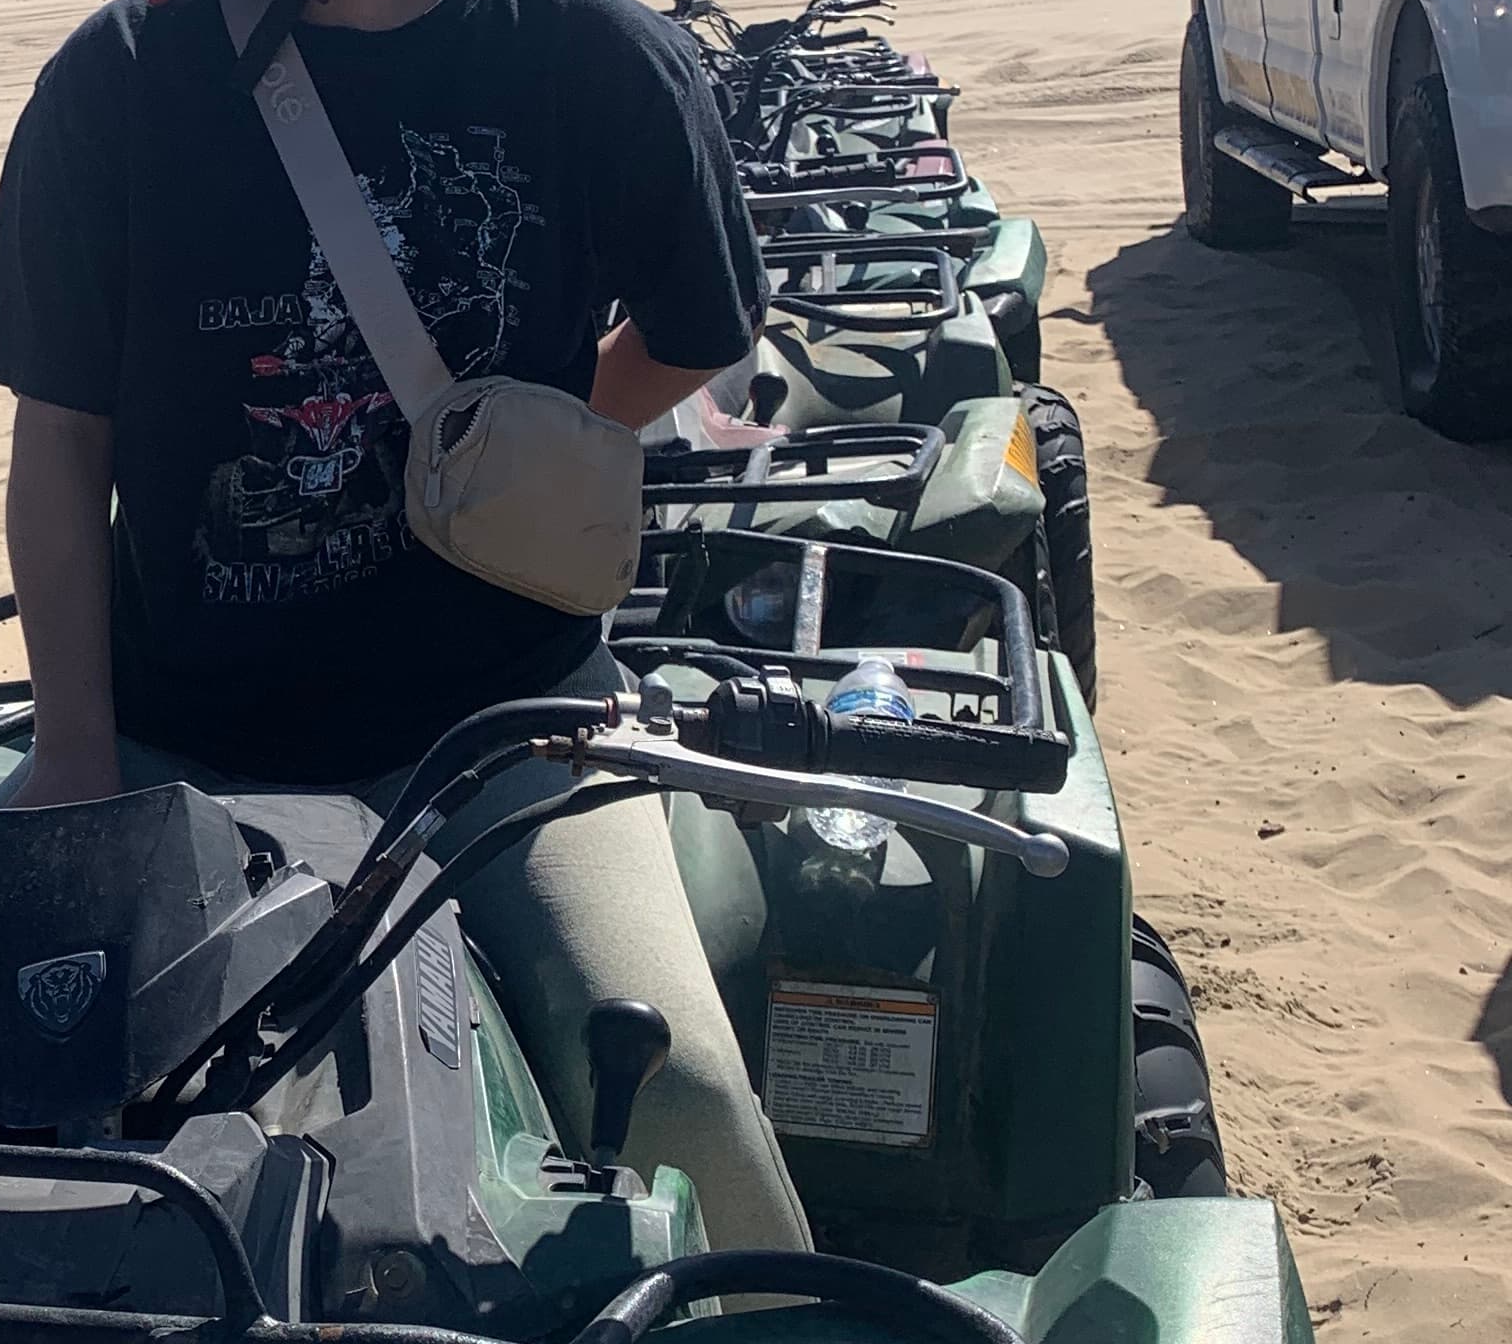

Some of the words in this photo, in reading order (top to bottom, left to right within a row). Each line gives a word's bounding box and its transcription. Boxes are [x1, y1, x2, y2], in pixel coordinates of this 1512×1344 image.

[199, 293, 303, 331] BAJA
[202, 561, 282, 603] SAN
[415, 926, 458, 1054] YAMAHA
